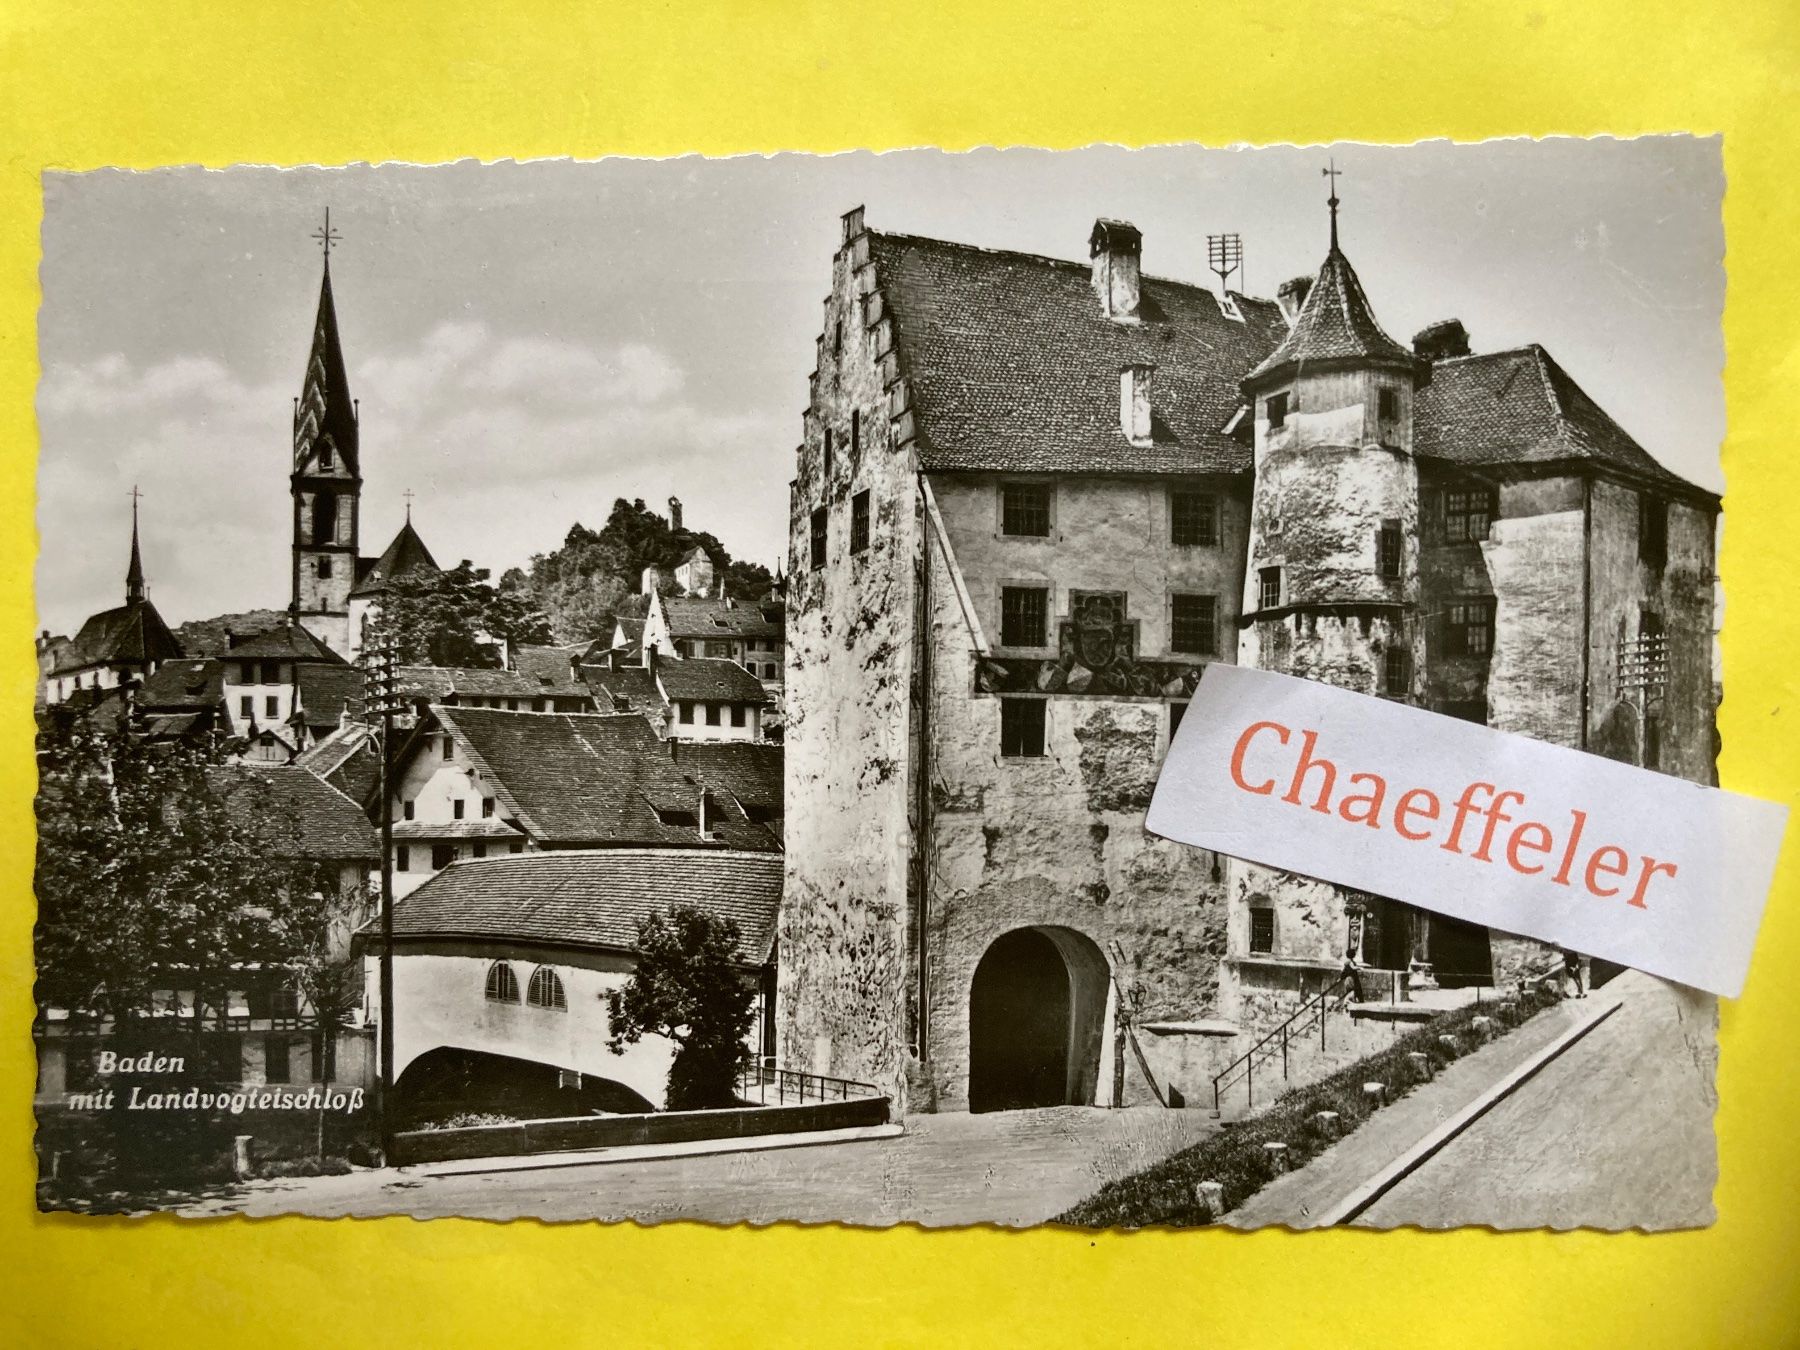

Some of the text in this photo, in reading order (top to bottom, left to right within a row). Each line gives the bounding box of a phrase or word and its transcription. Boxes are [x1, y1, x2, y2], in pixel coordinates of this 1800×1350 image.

[1230, 721, 1677, 908] Chaeffeler
[97, 1051, 186, 1074] Baden
[68, 1087, 365, 1114] mit Landvogteischloß
